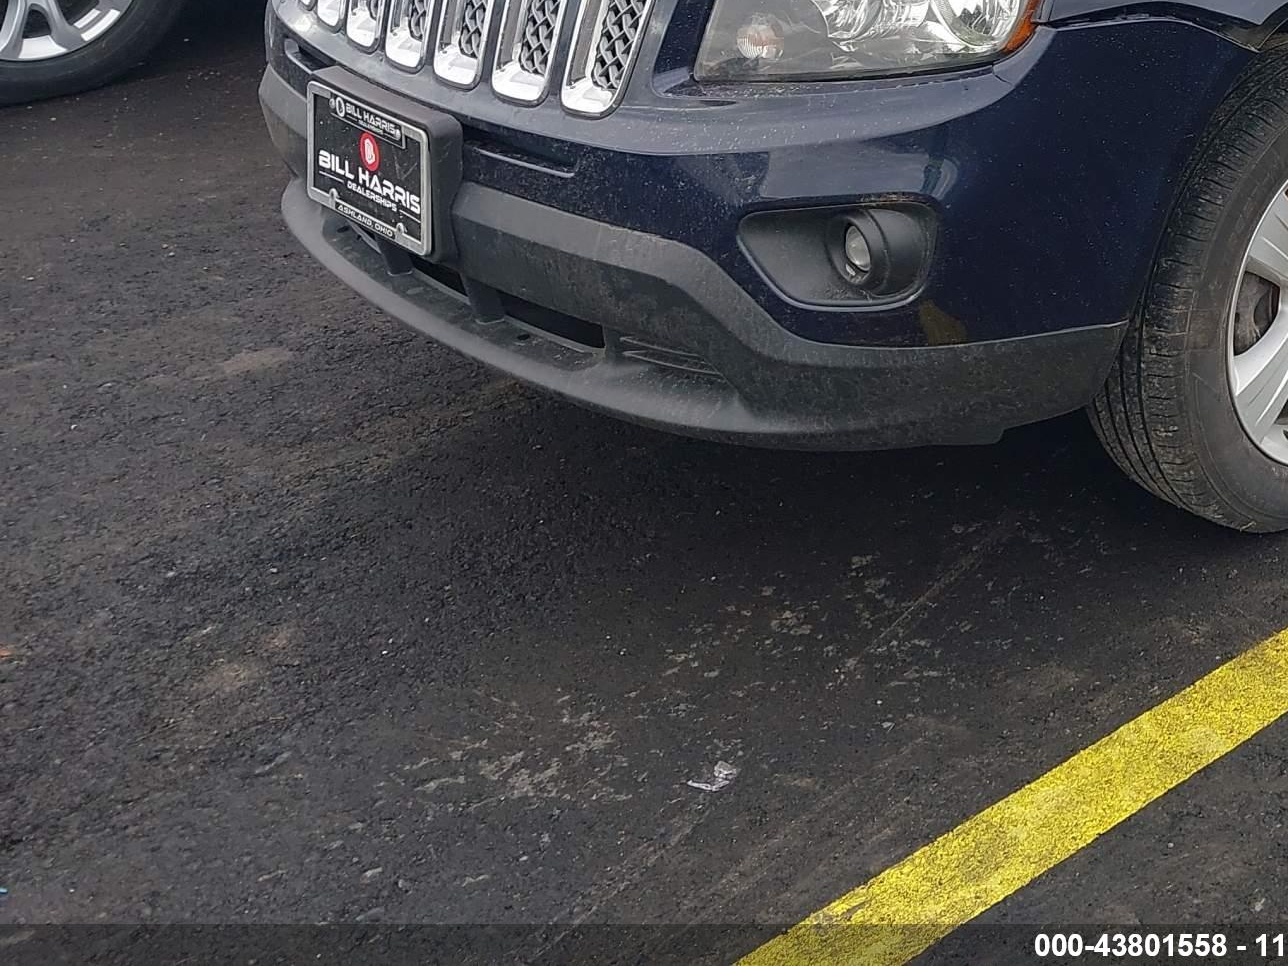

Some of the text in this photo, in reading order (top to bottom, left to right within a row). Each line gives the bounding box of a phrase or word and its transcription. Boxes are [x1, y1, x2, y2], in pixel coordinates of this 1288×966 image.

[345, 103, 362, 118] BILL
[363, 111, 396, 136] HARRIS
[318, 149, 421, 214] BILL HARRIS
[346, 181, 398, 212] DEALERSHIPS
[337, 205, 394, 239] ASHLAND, OHIO
